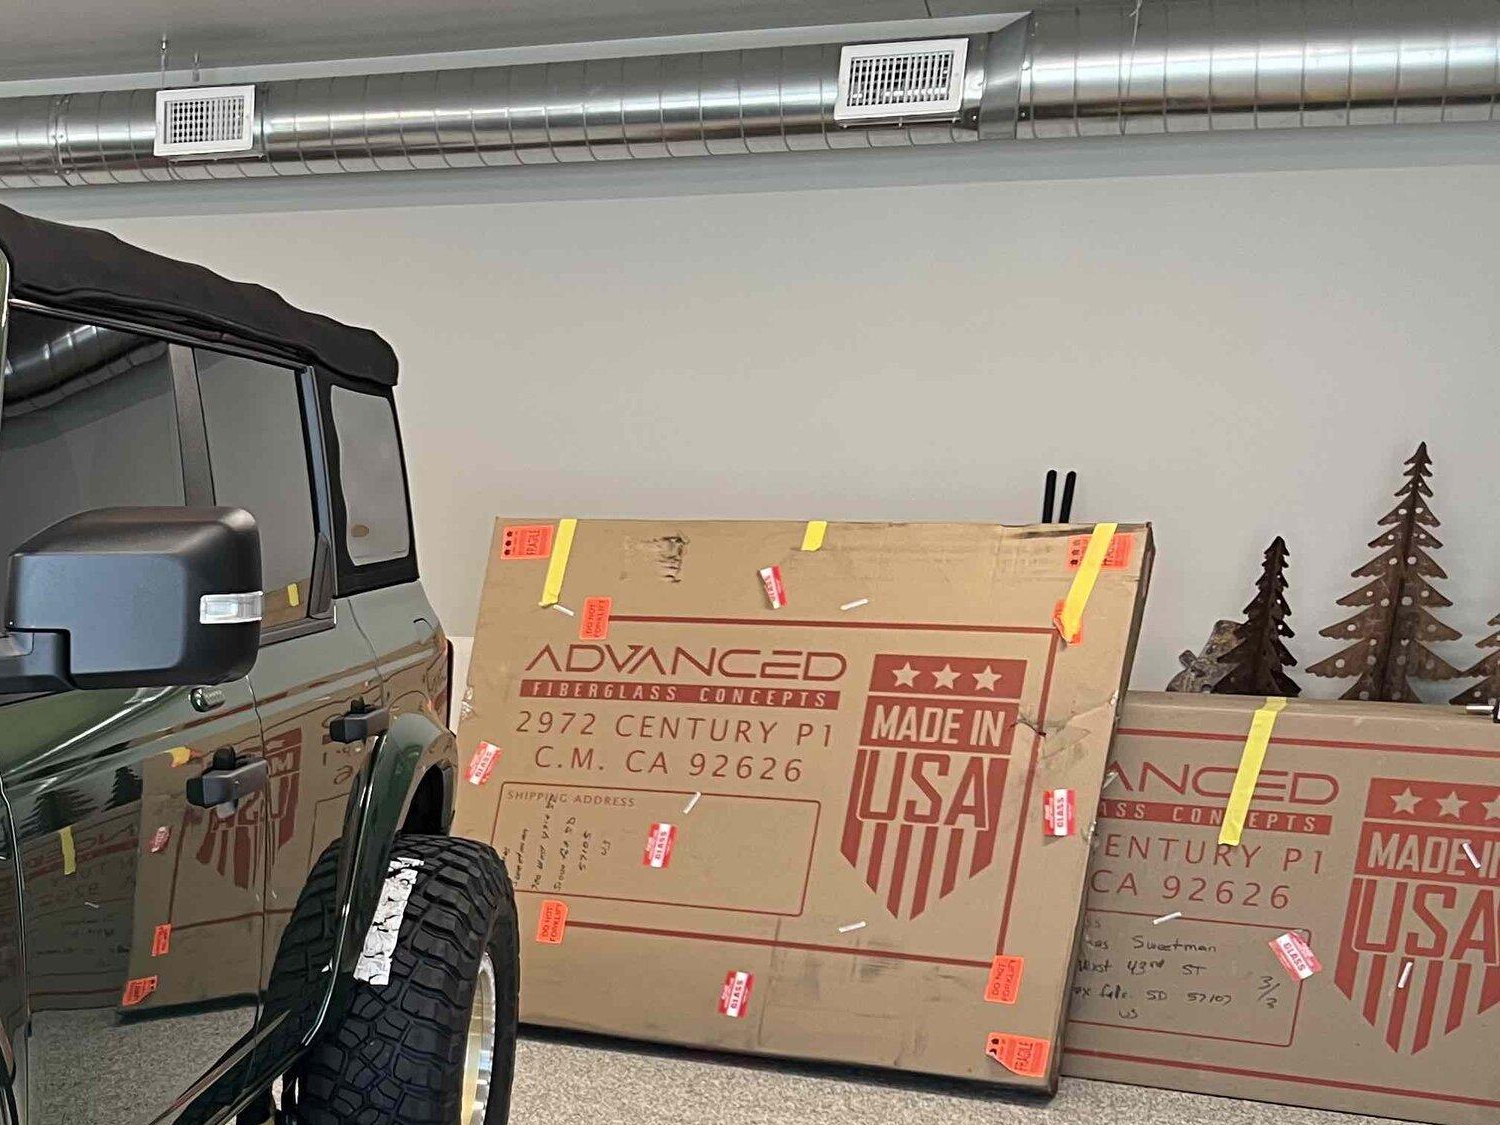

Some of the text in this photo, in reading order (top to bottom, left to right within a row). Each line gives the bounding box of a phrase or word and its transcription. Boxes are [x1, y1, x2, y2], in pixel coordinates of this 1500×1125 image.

[524, 643, 847, 682] ADVANCED
[532, 683, 827, 707] FIBERGLASS CONCEPTS
[515, 710, 597, 735] 2972
[615, 714, 778, 745] CENTURY
[871, 704, 1006, 747] MADE IN
[534, 746, 803, 782] C.M. CA 92626
[507, 790, 635, 807] SHIPPING ADDRESS
[859, 750, 987, 828] USA
[1101, 761, 1340, 805] ANCED
[1173, 807, 1316, 832] CONEPTS
[1104, 833, 1262, 868] ENTURY
[1367, 832, 1472, 876] MADE
[1090, 869, 1291, 909] CA 92626
[542, 925, 550, 937] DO
[1356, 878, 1497, 964] USA
[1284, 943, 1306, 971] GLASS
[730, 980, 743, 1009] GLASS
[992, 983, 1000, 996] DO
